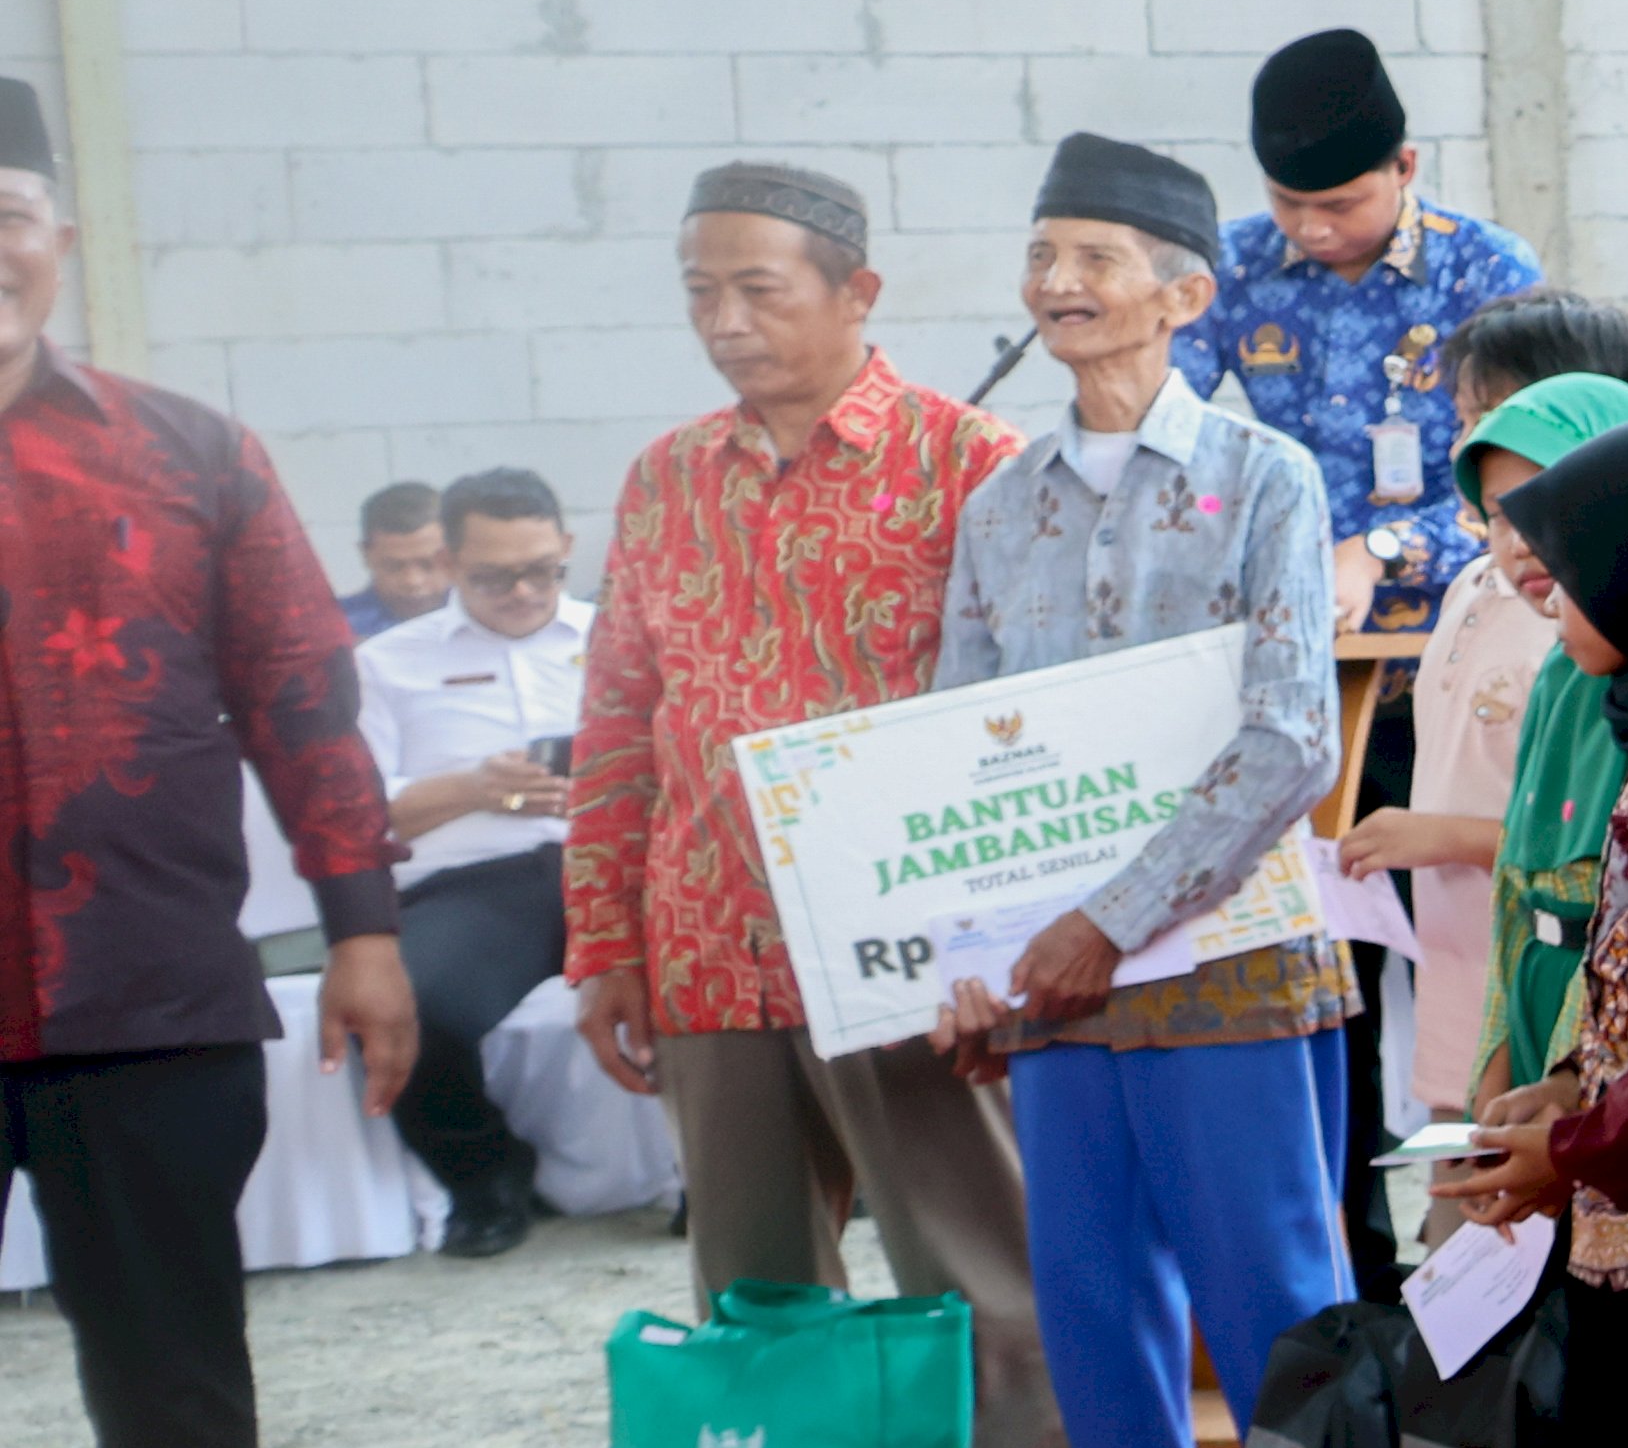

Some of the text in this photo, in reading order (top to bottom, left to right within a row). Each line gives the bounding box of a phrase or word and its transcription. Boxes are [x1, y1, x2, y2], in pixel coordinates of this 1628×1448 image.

[902, 761, 1139, 844] BANTUAN
[873, 786, 1196, 896] JAMBANISAS
[964, 844, 1117, 895] TOTAL SENILAI
[853, 935, 933, 981] Rp
